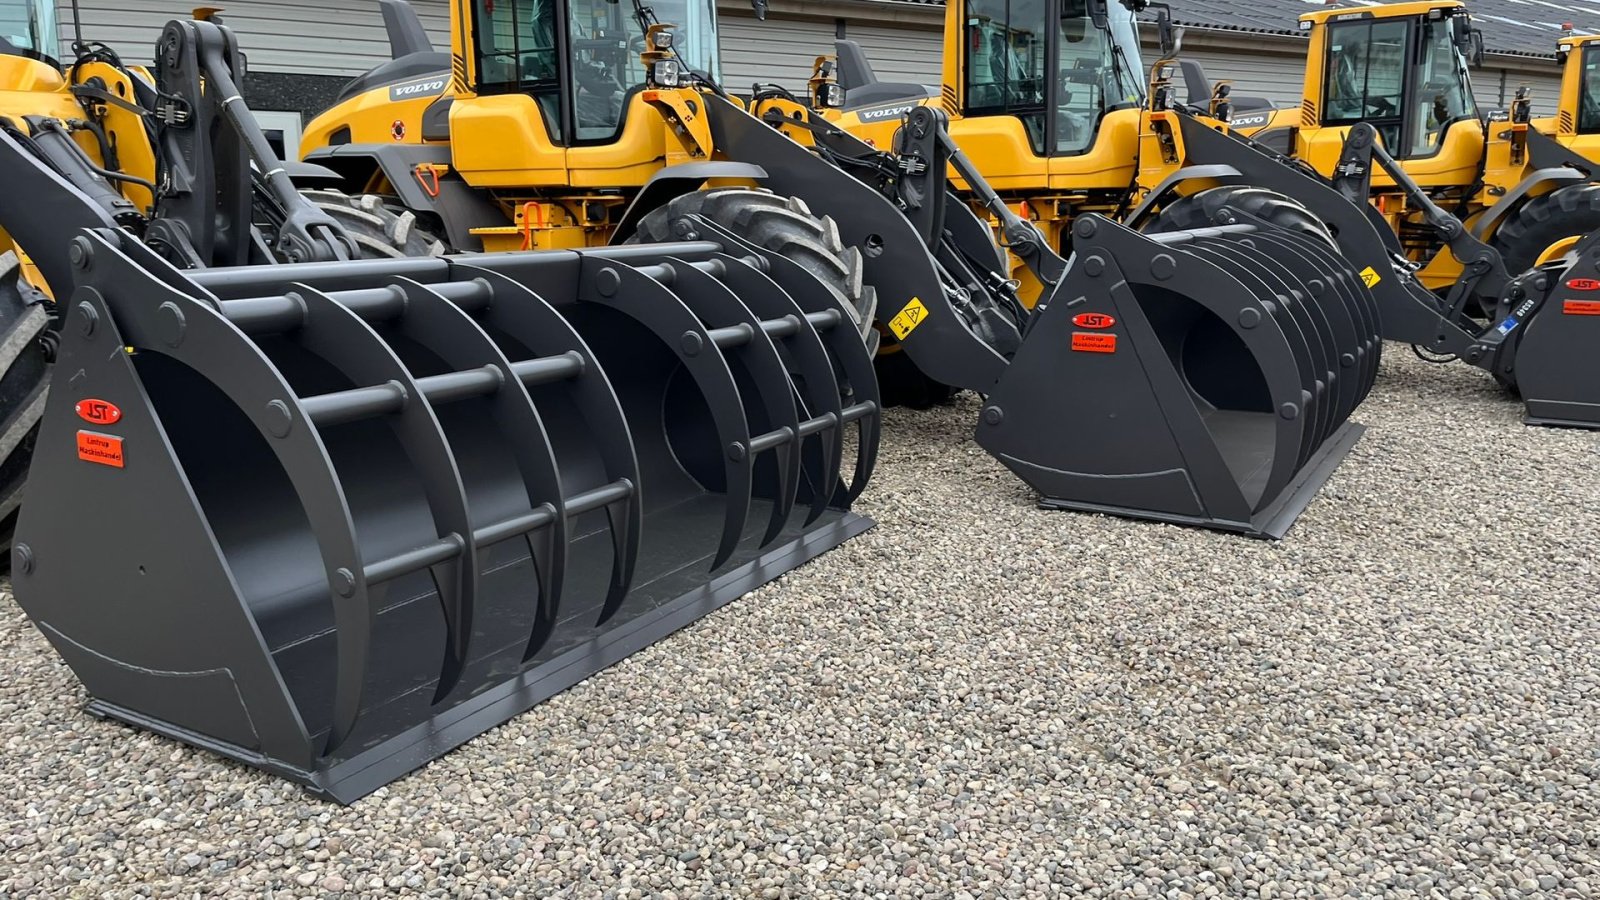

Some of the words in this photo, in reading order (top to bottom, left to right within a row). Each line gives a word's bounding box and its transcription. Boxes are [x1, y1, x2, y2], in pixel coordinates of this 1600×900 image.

[395, 81, 443, 96] VOLVO
[1230, 116, 1264, 125] LVO
[1083, 315, 1105, 326] JST
[87, 403, 108, 421] JST
